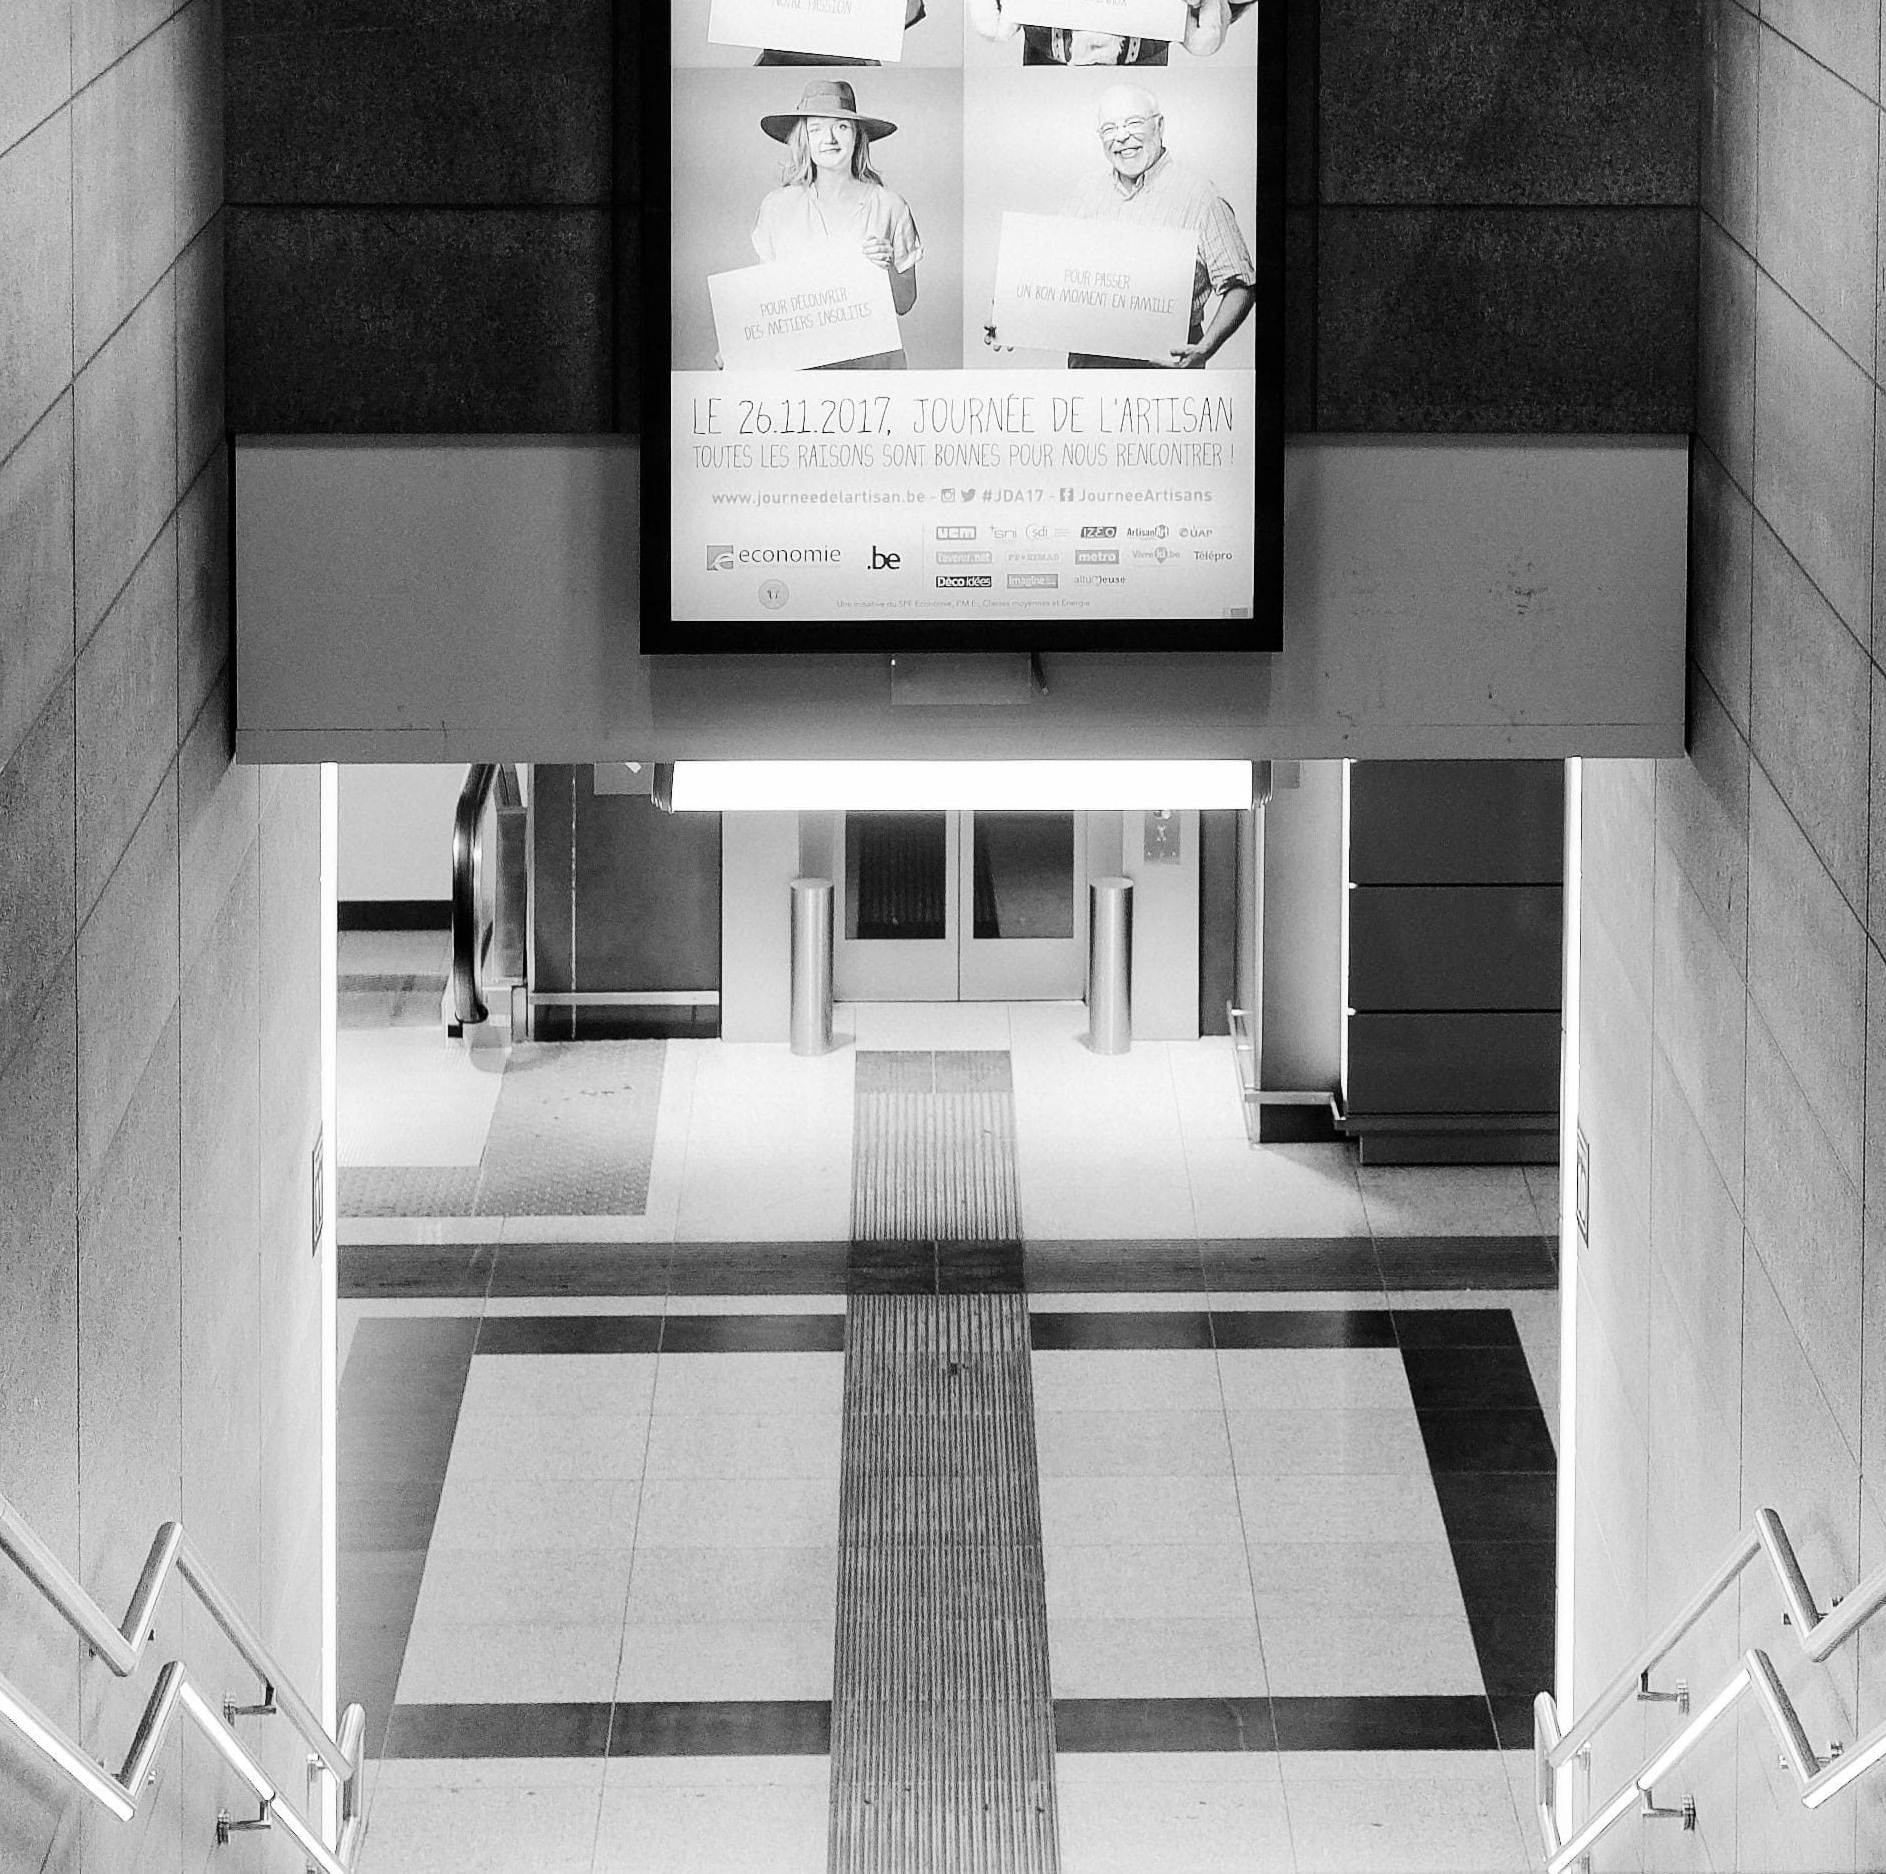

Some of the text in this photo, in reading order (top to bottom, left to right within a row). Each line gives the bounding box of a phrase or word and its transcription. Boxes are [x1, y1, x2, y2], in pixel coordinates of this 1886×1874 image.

[1064, 269, 1131, 290] POUR PASSER
[760, 299, 788, 317] POUR
[1016, 284, 1175, 314] UN BON MOMENT EN FAMILLE
[744, 324, 764, 341] DES
[817, 302, 873, 327] INSOLITES
[692, 393, 1233, 436] LE 26.11.2017, JOURNÉE DE L'ARTISAN
[692, 443, 753, 468] TOUTES
[760, 443, 790, 468] LES
[798, 443, 874, 468] RAISONS
[882, 443, 927, 468] SONT
[934, 443, 1001, 468] BONNES
[1009, 443, 1054, 468] POUR
[1062, 443, 1108, 468] NOUS
[1116, 442, 1223, 468] RENCONTRER
[711, 488, 926, 507] www.journeedelartisan.be
[981, 488, 1044, 503] #JDA17
[1078, 488, 1215, 503] JourneeArtisans
[738, 544, 842, 563] economie
[866, 544, 902, 570] .be
[1192, 550, 1233, 562] Télépro
